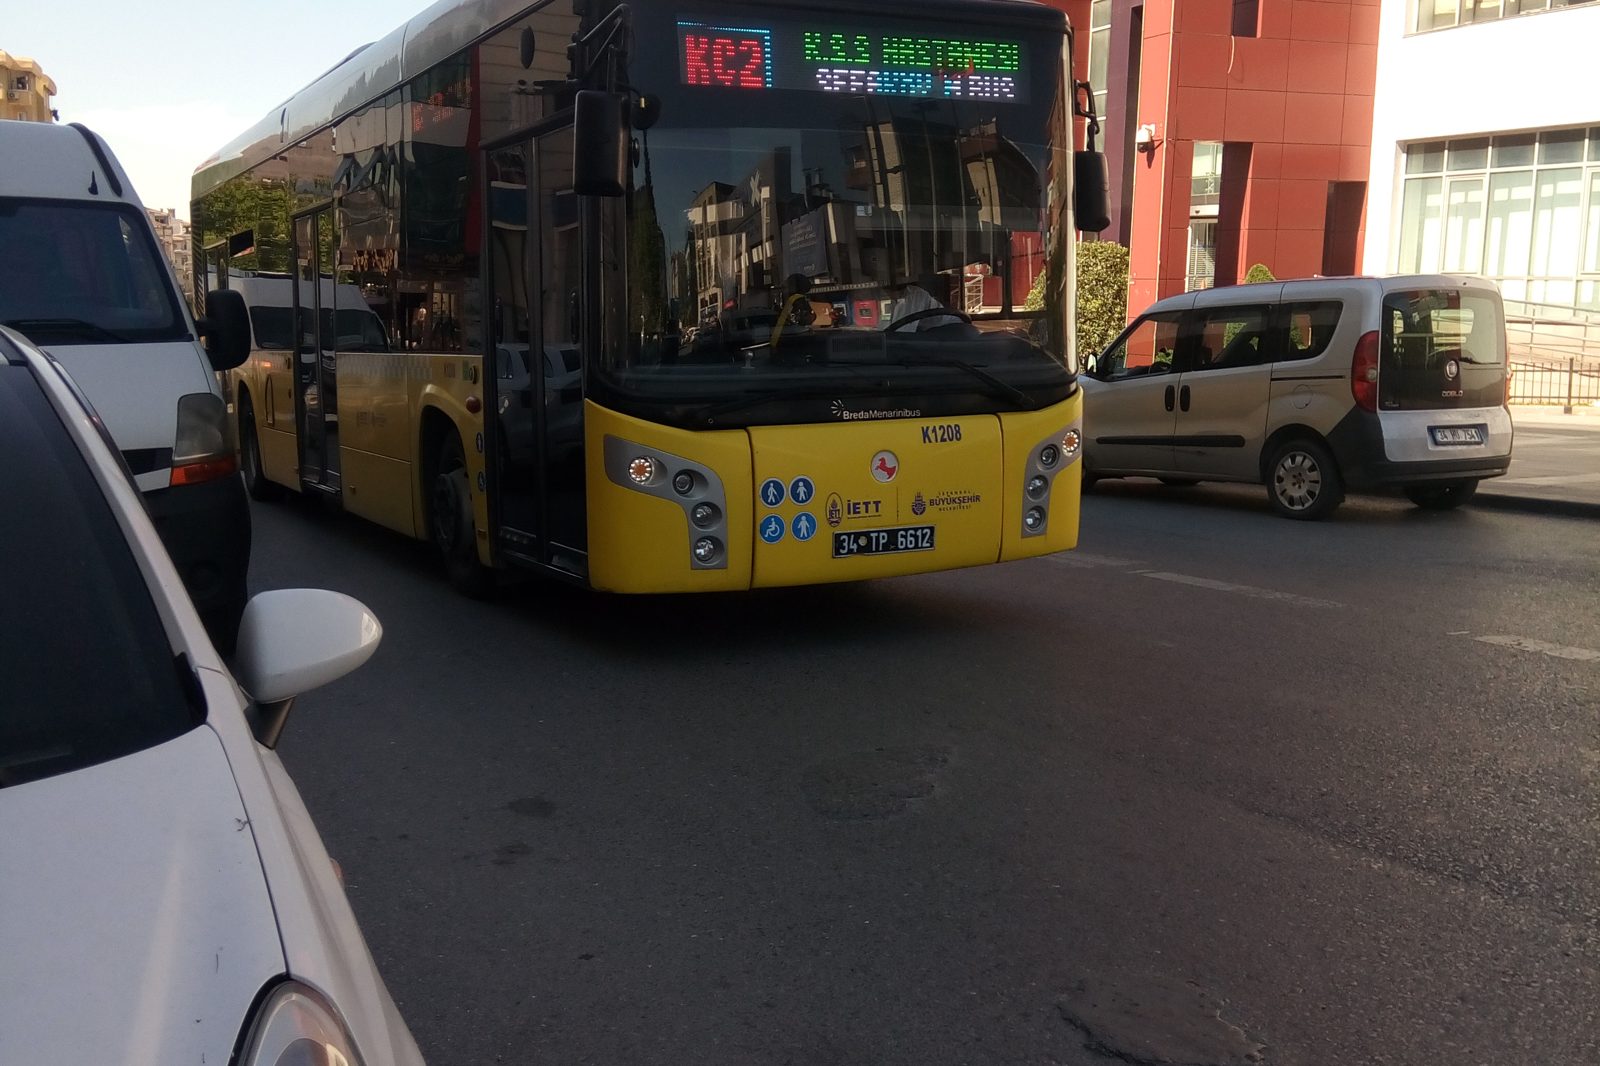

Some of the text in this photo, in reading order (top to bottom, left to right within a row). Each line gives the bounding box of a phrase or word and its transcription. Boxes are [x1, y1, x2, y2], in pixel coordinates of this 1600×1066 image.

[921, 424, 962, 444] K1208
[839, 528, 931, 554] 34 TP 6612
